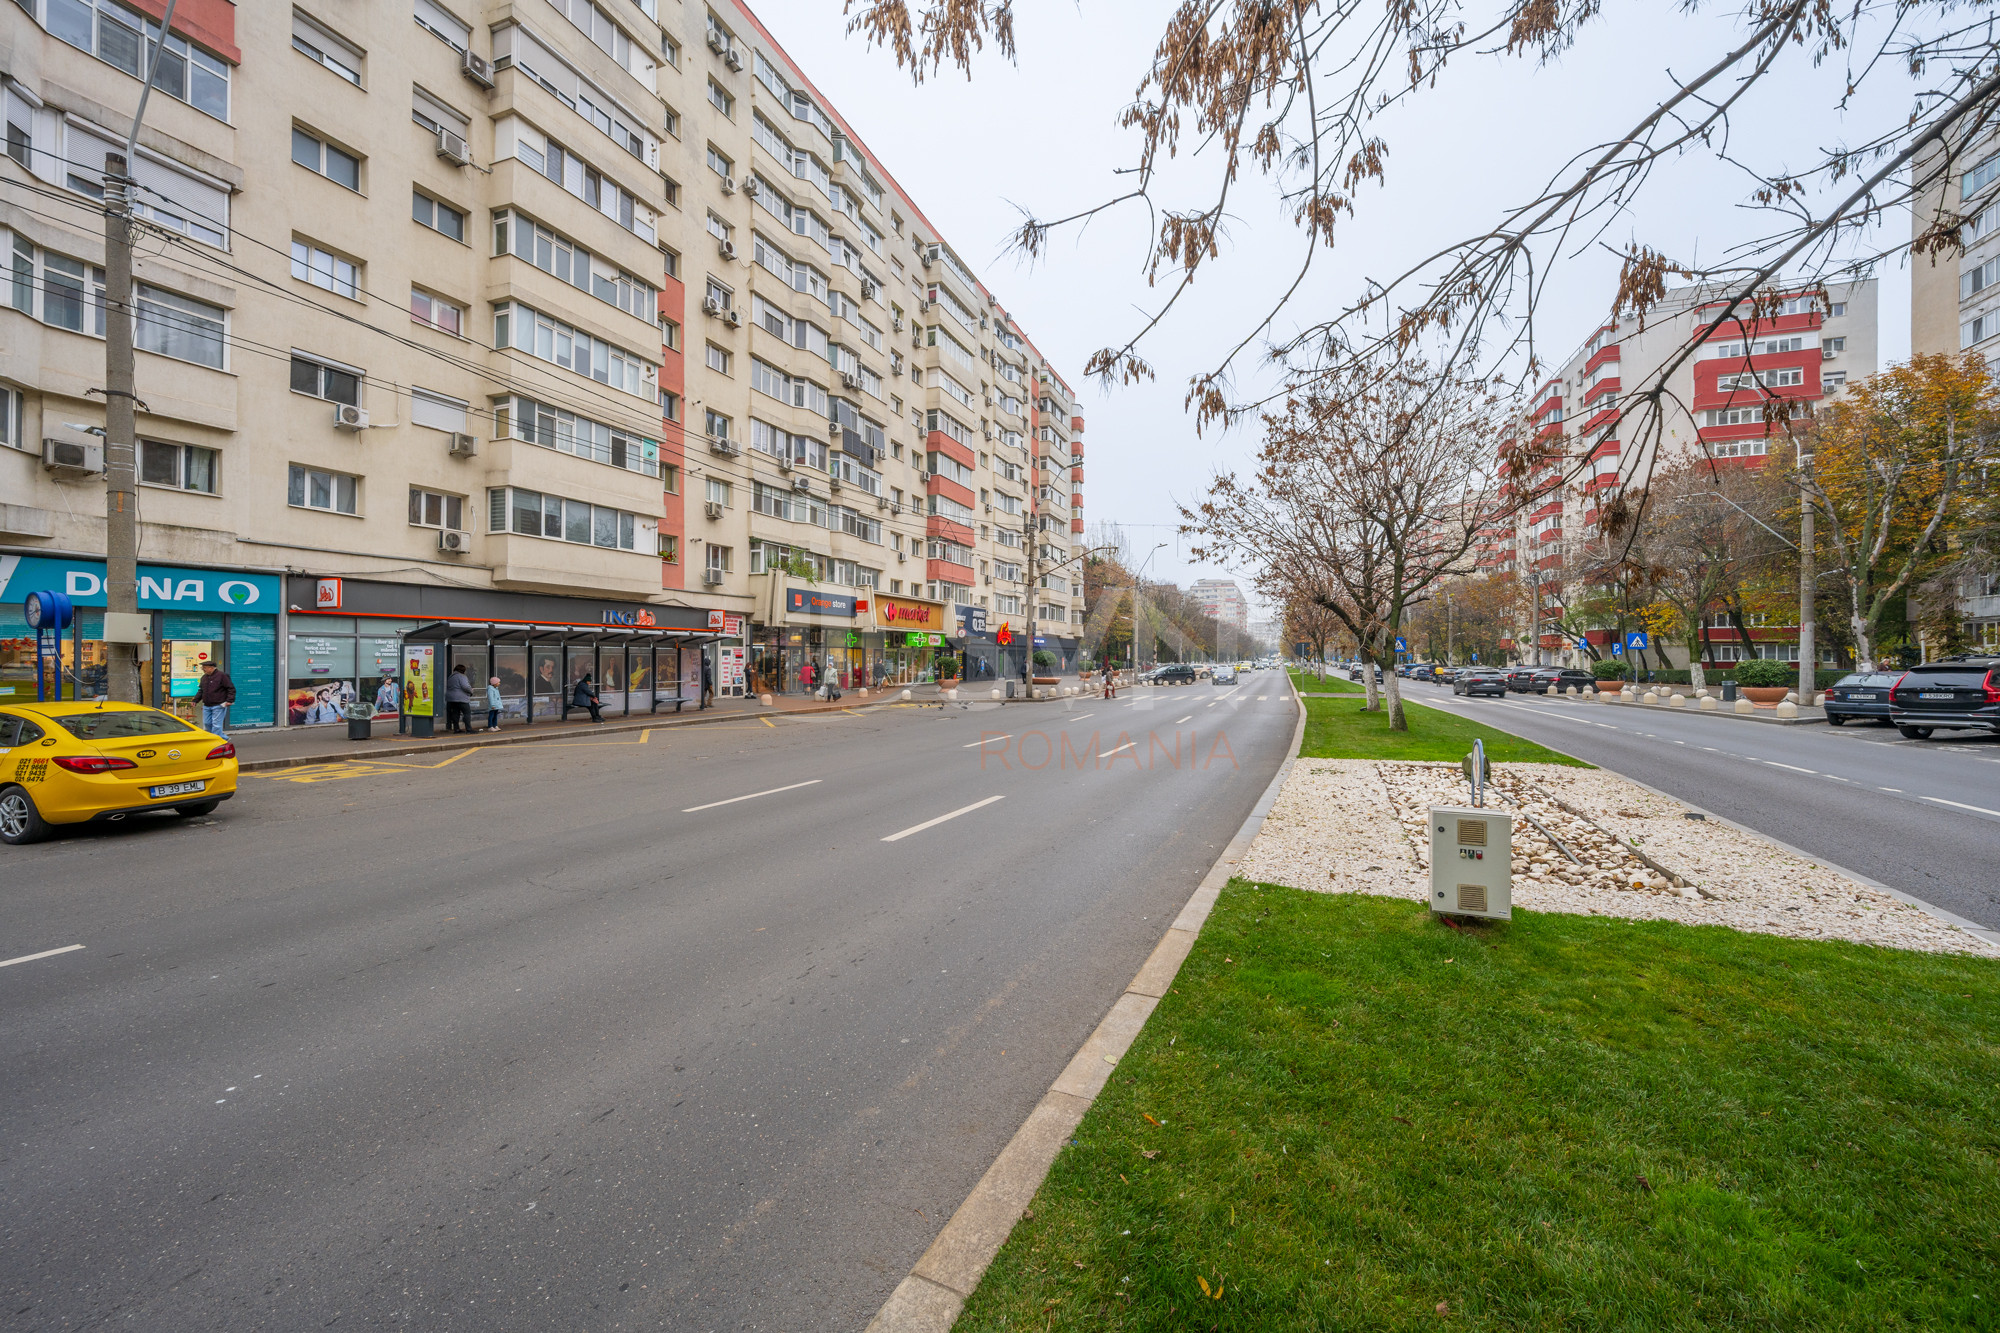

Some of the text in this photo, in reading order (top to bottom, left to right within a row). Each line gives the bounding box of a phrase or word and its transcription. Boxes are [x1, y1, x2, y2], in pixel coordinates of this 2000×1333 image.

[66, 571, 204, 602] DNA
[811, 597, 832, 608] Orange
[832, 600, 846, 608] store
[601, 610, 635, 625] ING
[899, 605, 931, 622] market
[169, 785, 179, 793] 39
[184, 782, 201, 791] EML
